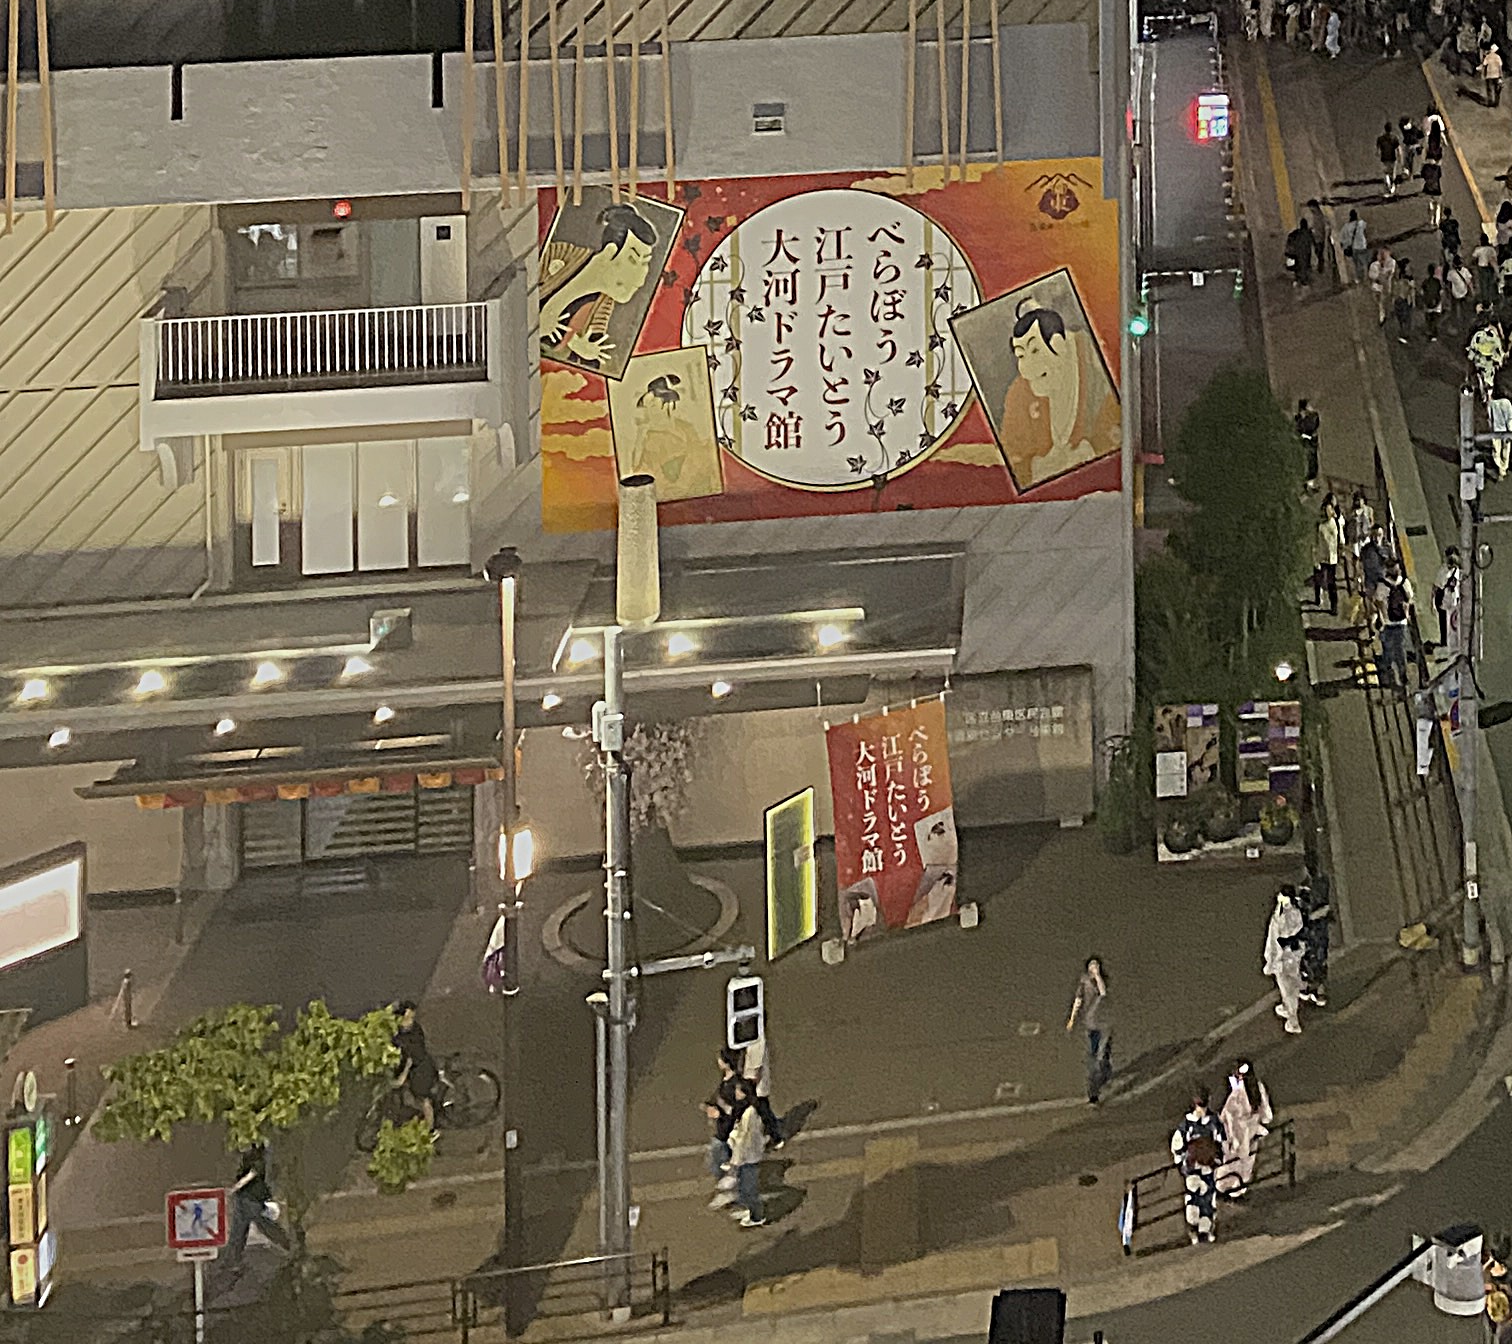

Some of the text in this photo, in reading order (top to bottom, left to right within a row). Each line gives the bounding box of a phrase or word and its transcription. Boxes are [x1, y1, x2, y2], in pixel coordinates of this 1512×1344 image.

[762, 229, 803, 450] 大河ドラマ館
[815, 226, 853, 446] 江戸たいとう
[867, 222, 906, 364] べらぼう
[856, 740, 884, 875] 大河ドラマ館
[882, 733, 907, 867] 江戸たいとう
[909, 725, 932, 812] べらぼう
